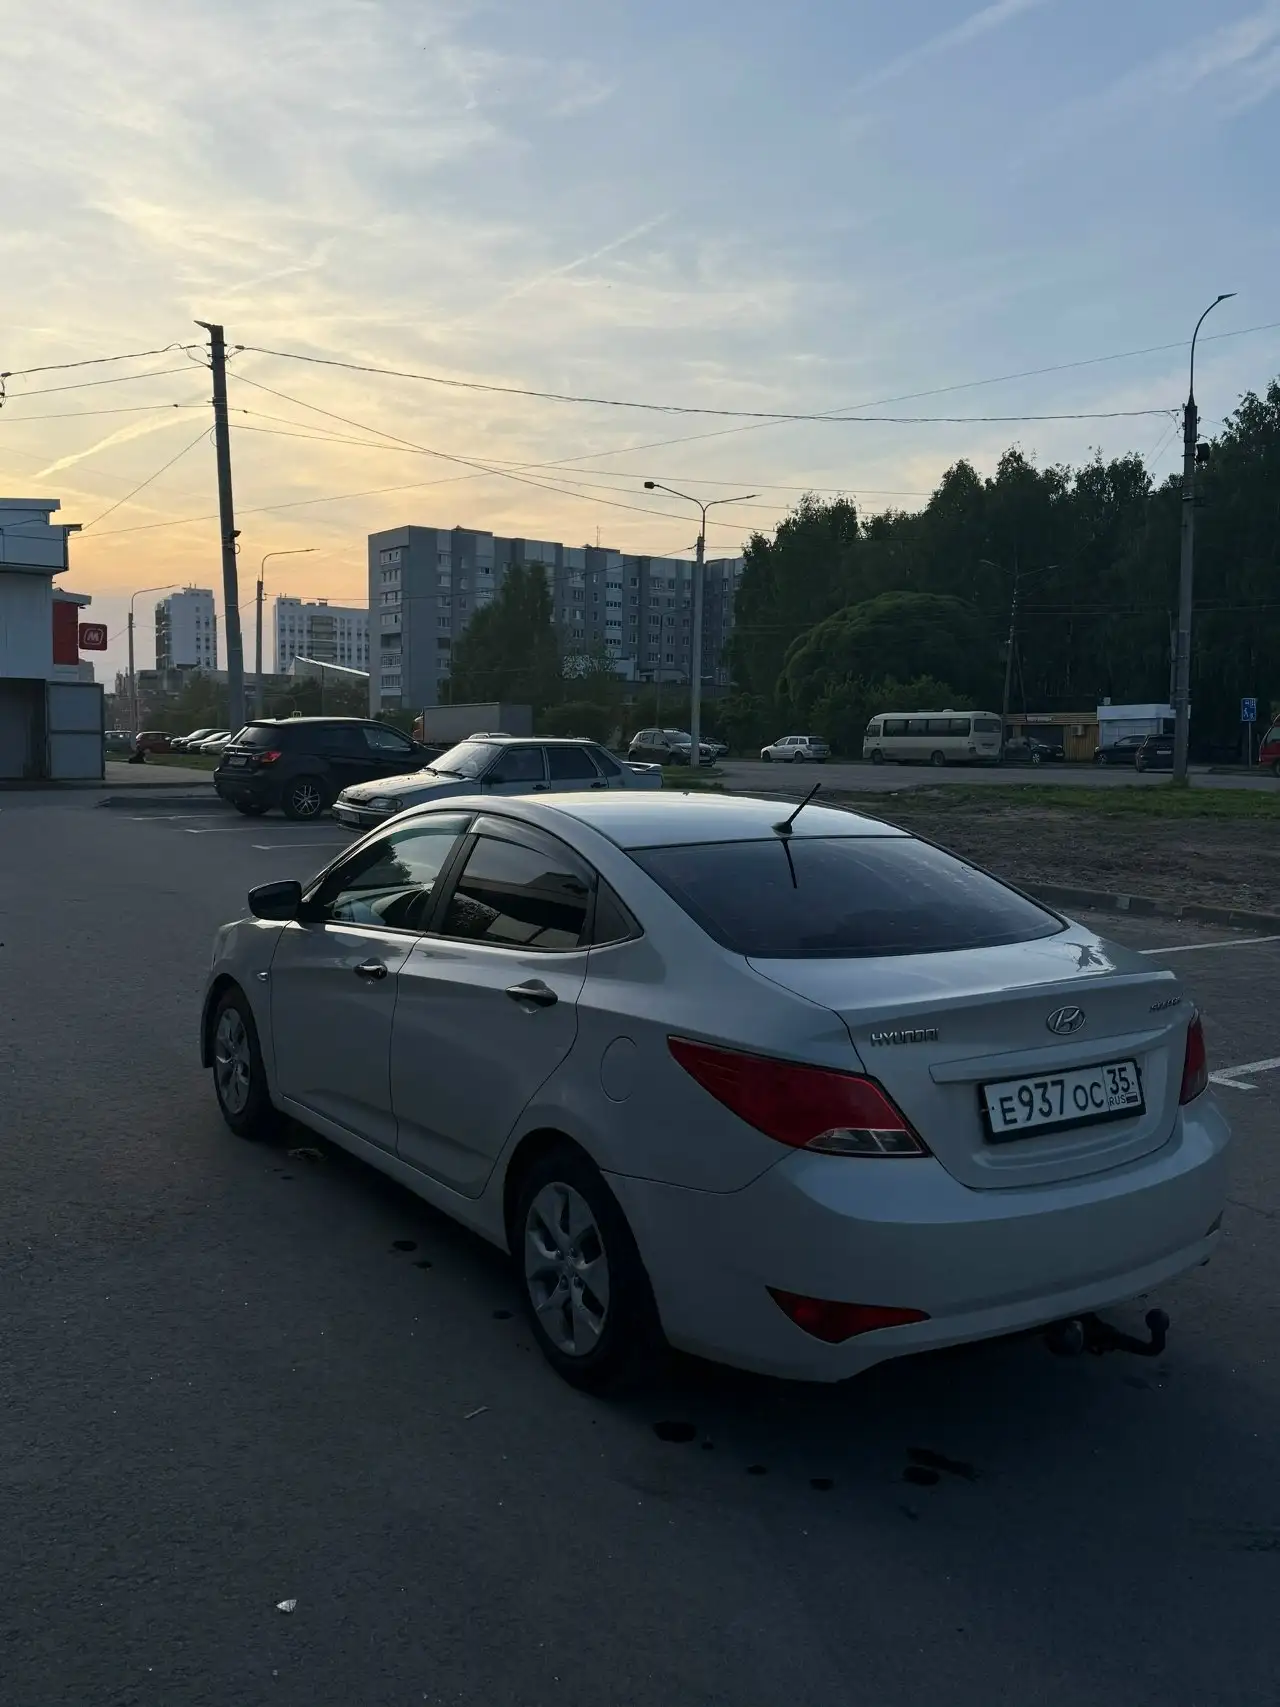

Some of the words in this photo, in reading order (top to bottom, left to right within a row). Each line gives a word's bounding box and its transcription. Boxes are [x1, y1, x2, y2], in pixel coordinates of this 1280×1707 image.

[870, 1028, 939, 1046] HYUNDAI
[1107, 1067, 1130, 1095] 35
[1109, 1095, 1126, 1106] RUS
